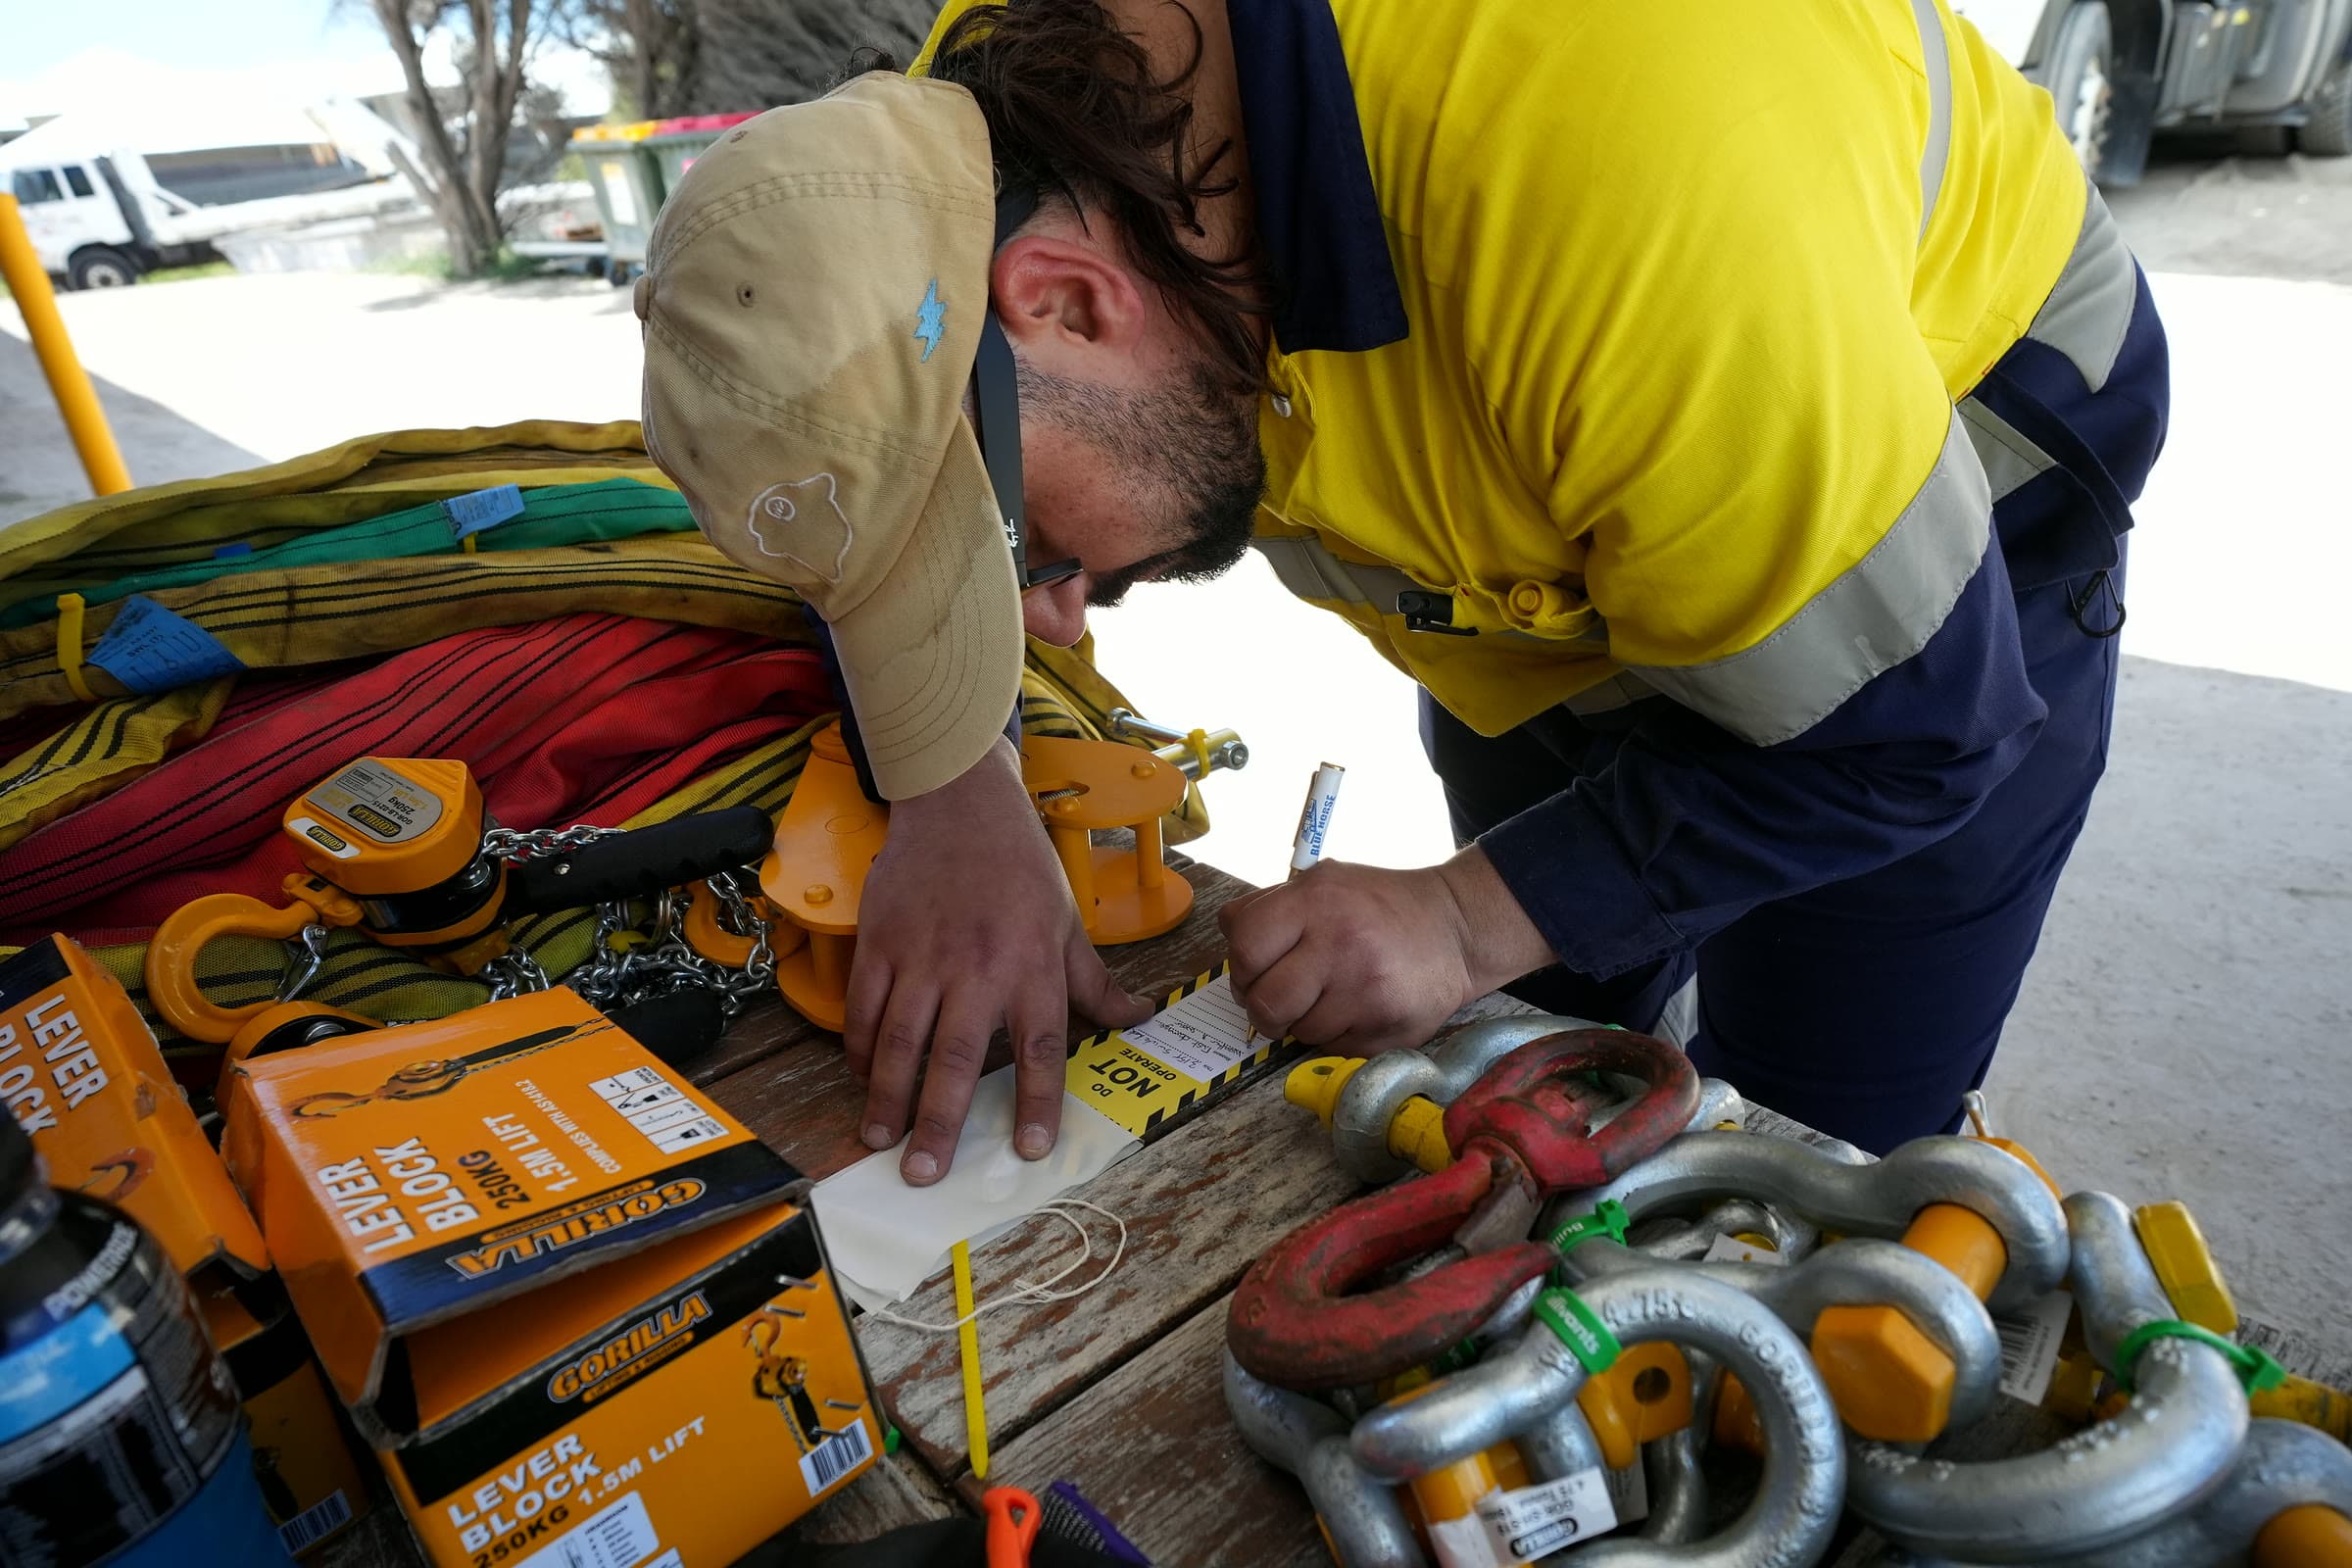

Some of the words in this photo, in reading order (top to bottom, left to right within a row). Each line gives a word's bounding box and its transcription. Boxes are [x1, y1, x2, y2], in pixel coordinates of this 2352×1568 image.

[353, 806, 397, 835] GORILLA
[388, 796, 416, 815] 250kg
[1310, 830, 1323, 856] BLUE
[1317, 794, 1336, 829] HORSE
[307, 826, 345, 851] GORILLA
[24, 994, 110, 1110] LEVER
[1119, 1048, 1177, 1081] OPERATE
[1088, 1058, 1161, 1099] NOT
[1091, 1083, 1114, 1098] DO
[482, 1112, 539, 1152] LIFT
[547, 1110, 578, 1135] WITH
[517, 1148, 578, 1192] 1.5M
[569, 1131, 622, 1174] COMPLIES
[373, 1136, 480, 1233] BLOCK
[458, 1150, 531, 1209] 250KG
[317, 1155, 416, 1254] LEVER
[445, 1177, 707, 1280] GORILLA
[1551, 1222, 1585, 1248] Bulli
[547, 1291, 713, 1403] GORILLA
[447, 1433, 585, 1529] LEVER
[460, 1452, 603, 1553] BLOCK
[472, 1503, 570, 1568] 250KG
[578, 1457, 643, 1506] 1.5M
[648, 1415, 706, 1463] LIFT
